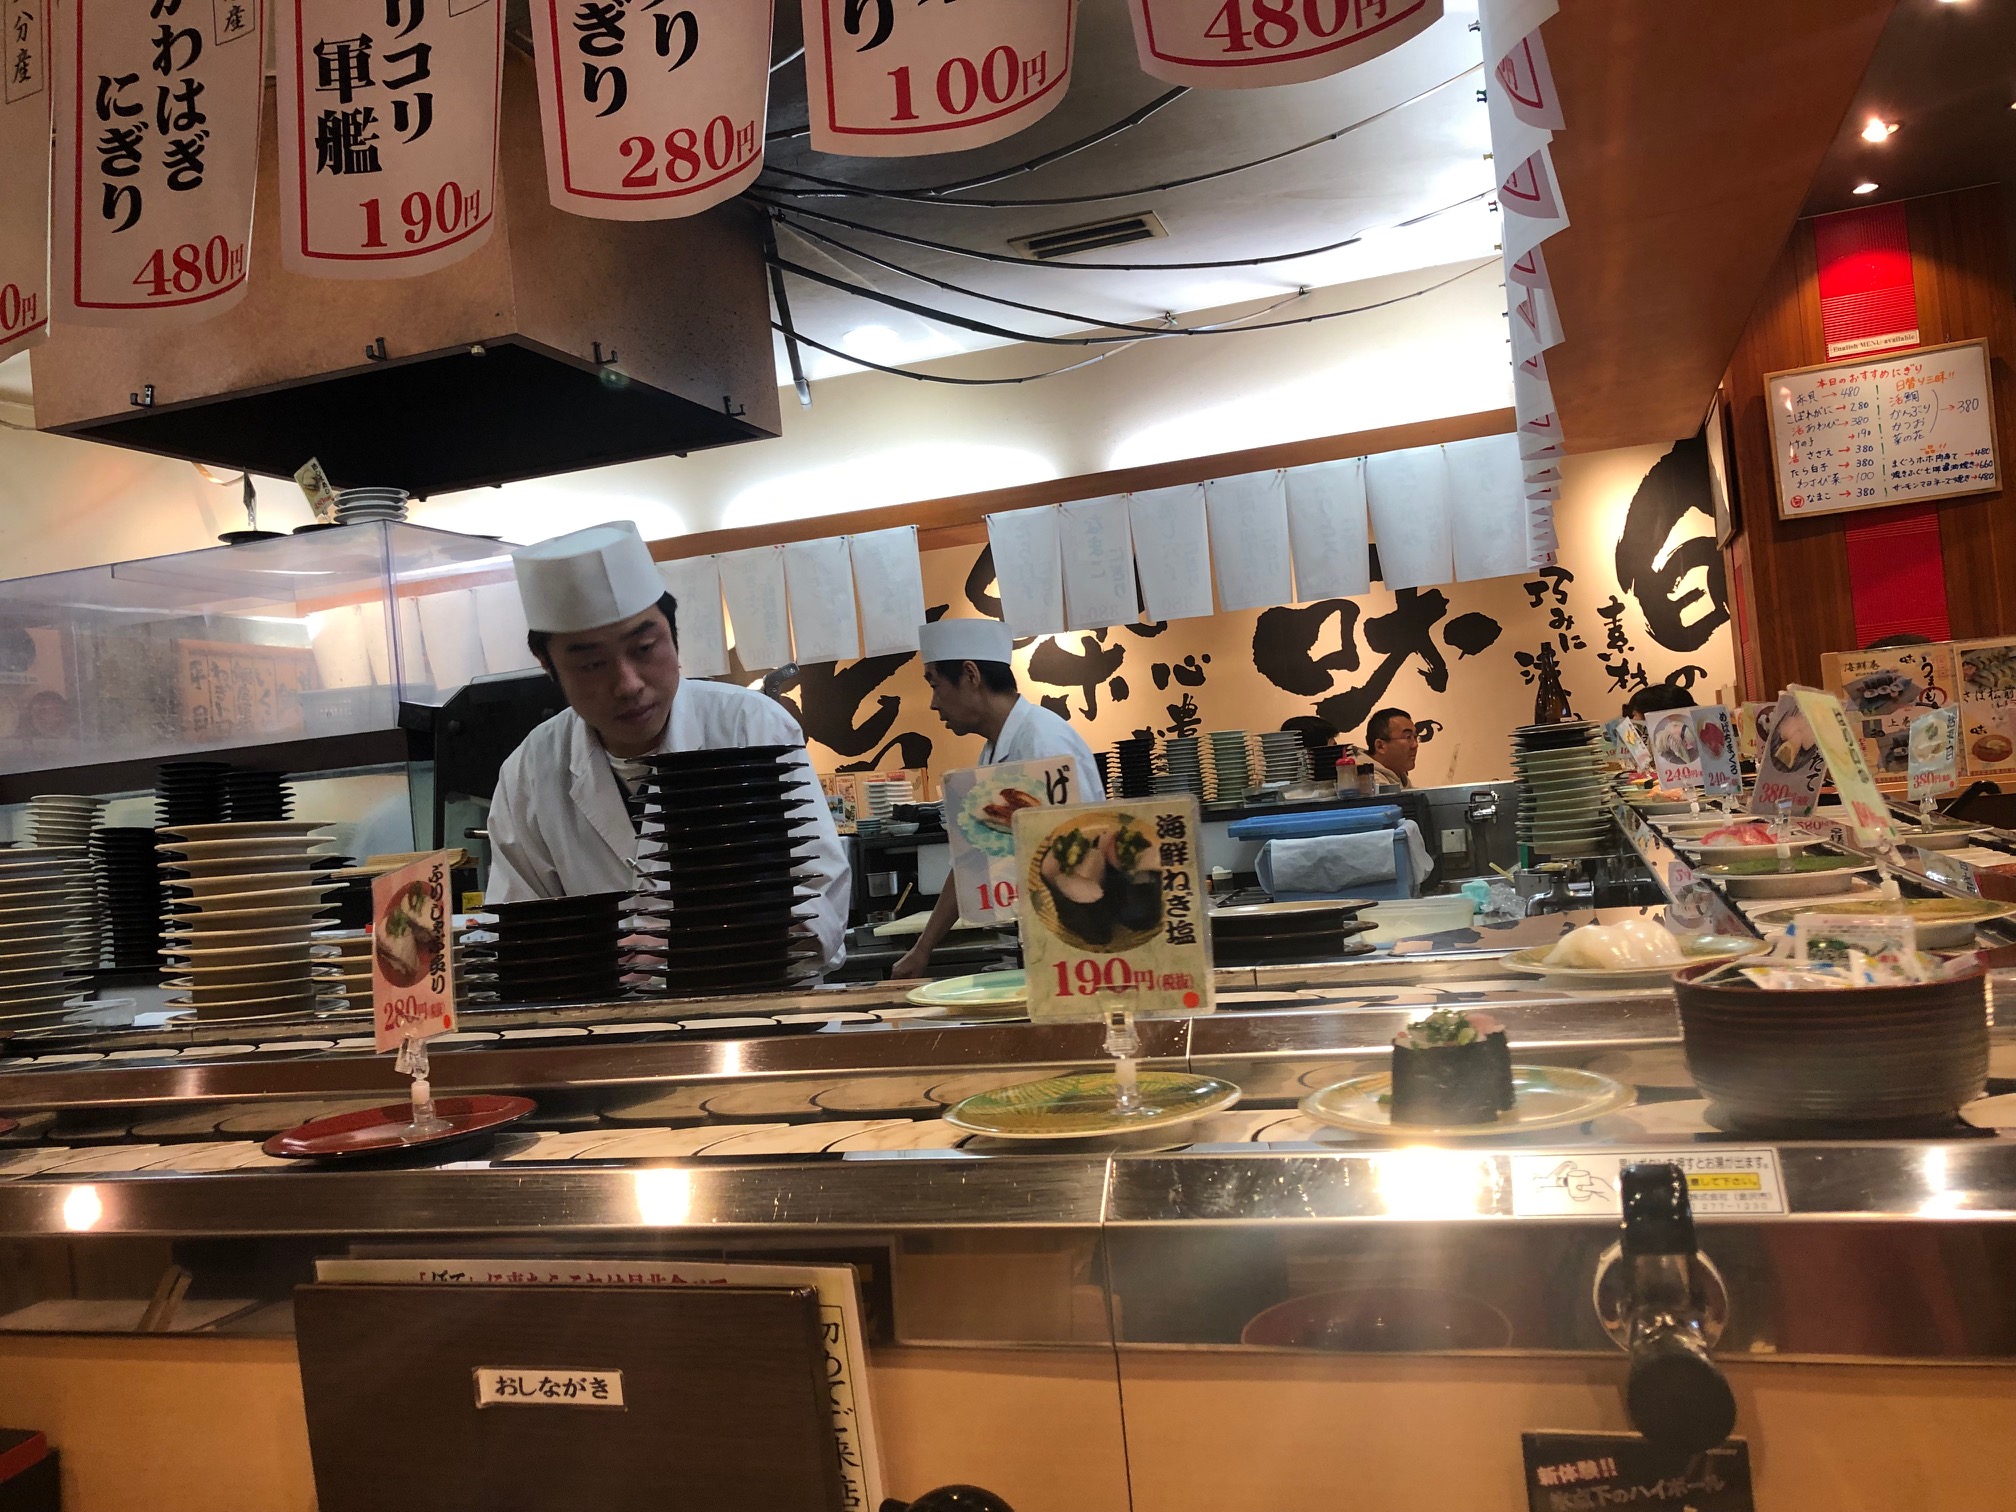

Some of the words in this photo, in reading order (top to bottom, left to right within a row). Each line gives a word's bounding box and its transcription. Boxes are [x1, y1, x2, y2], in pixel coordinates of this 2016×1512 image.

[887, 45, 1047, 122] 100円
[313, 33, 383, 176] 軍艦
[95, 72, 149, 234] にぎり
[619, 115, 755, 188] 280円
[359, 181, 481, 248] 190円
[132, 235, 244, 297] 480円
[1833, 344, 1858, 352] English
[1860, 340, 1881, 348] MENU
[1884, 334, 1915, 344] available
[1817, 364, 1923, 388] 本日のおすすめにぎり
[1841, 386, 1860, 399] 480
[1850, 402, 1869, 412] 280
[1958, 397, 1980, 413] 380
[1851, 417, 1869, 426] 380
[1855, 445, 1874, 454] 380
[1975, 447, 1990, 456] 480
[1856, 459, 1874, 467] 380
[1856, 471, 1875, 483] 100
[1978, 473, 1994, 481] 480
[1856, 487, 1875, 498] 380
[1156, 813, 1197, 946] 海鮮ねぎ塩
[495, 1375, 609, 1400] おしながき
